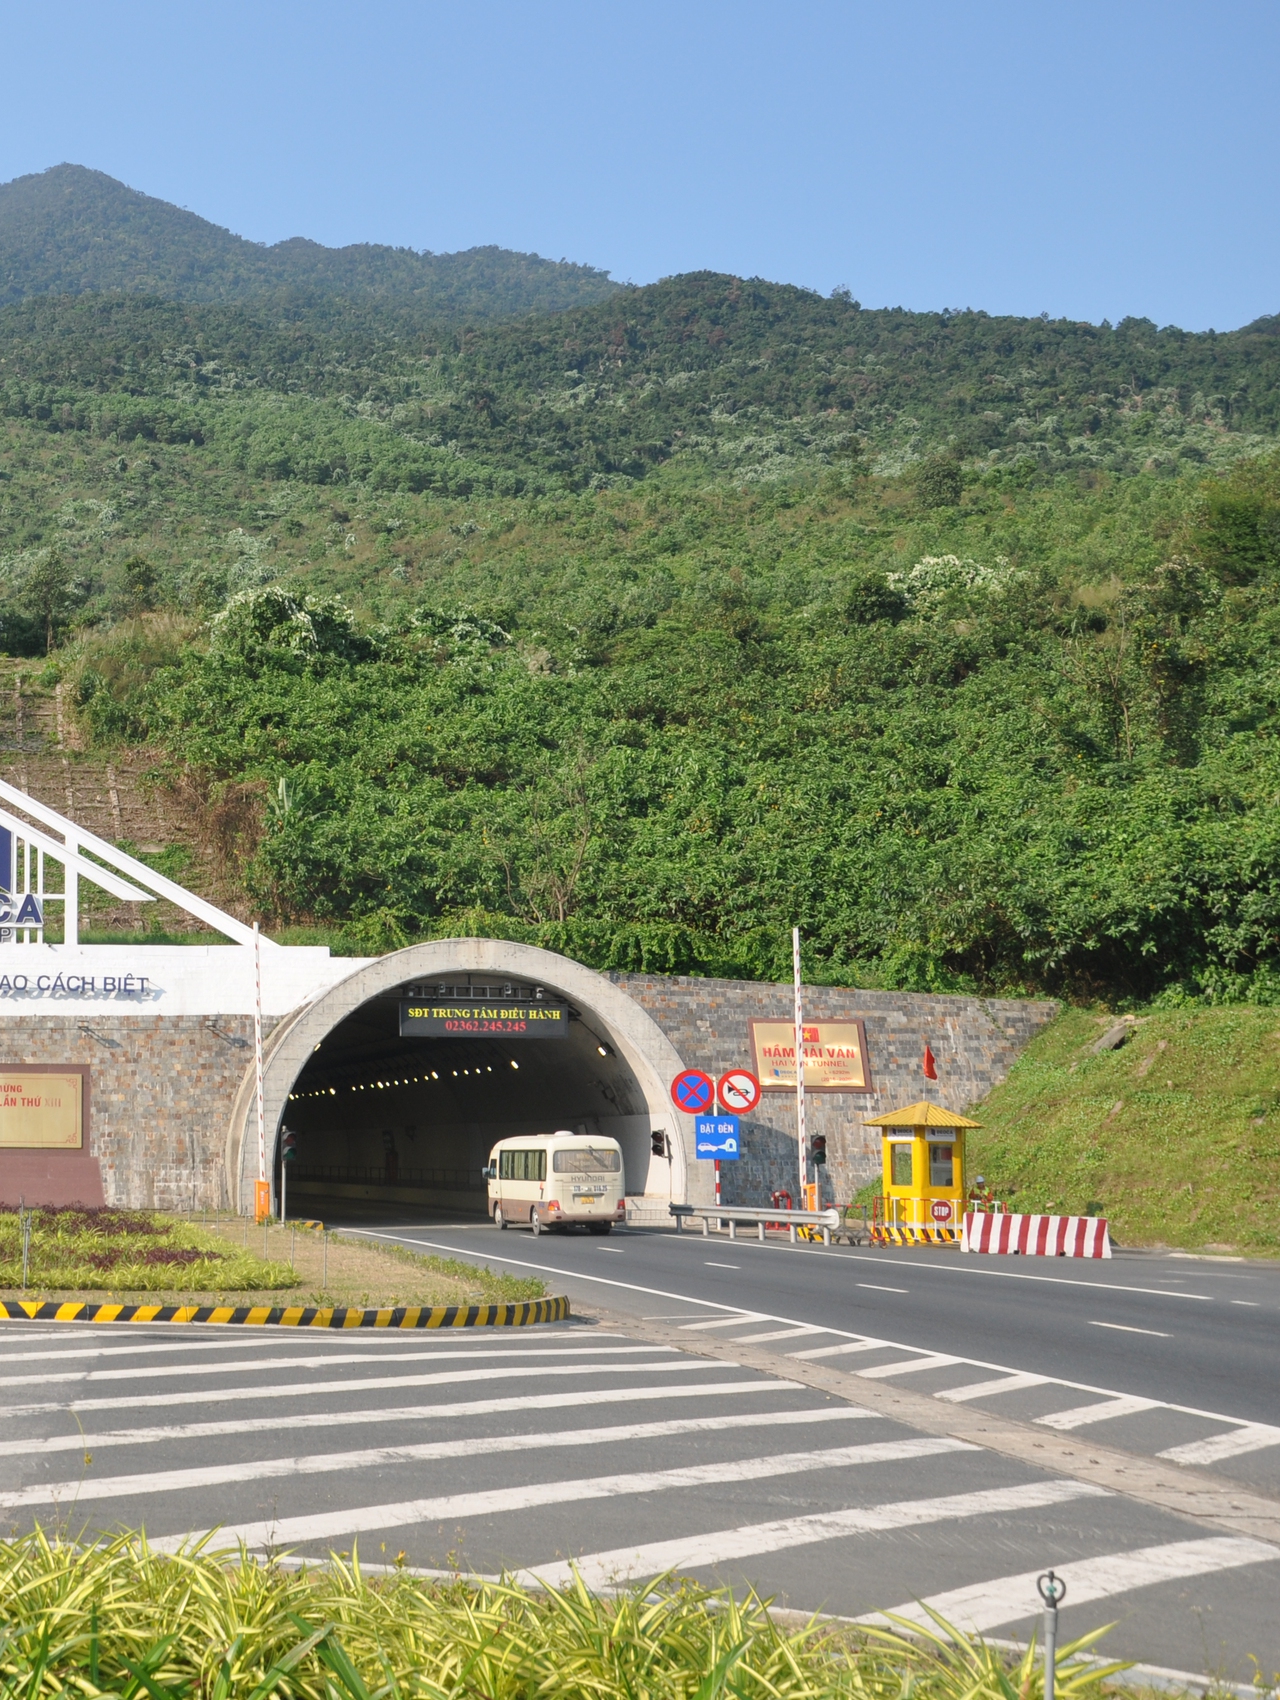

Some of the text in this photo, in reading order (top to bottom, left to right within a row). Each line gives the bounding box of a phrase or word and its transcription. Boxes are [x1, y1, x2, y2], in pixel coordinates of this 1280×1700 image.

[37, 972, 95, 992] CÁCH
[103, 973, 149, 996] BIỆT
[408, 1008, 429, 1018] SĐT
[432, 1008, 470, 1019] TRUNG
[473, 1007, 498, 1019] TÂM
[529, 1009, 560, 1020] HÀNH
[445, 1020, 527, 1032] 02362.245.245
[827, 1046, 855, 1059] VÂN
[21, 1095, 42, 1107] THỨ
[44, 1097, 62, 1107] XIII
[700, 1122, 734, 1135] BẬT ĐÈN
[934, 1206, 949, 1216] STOP
